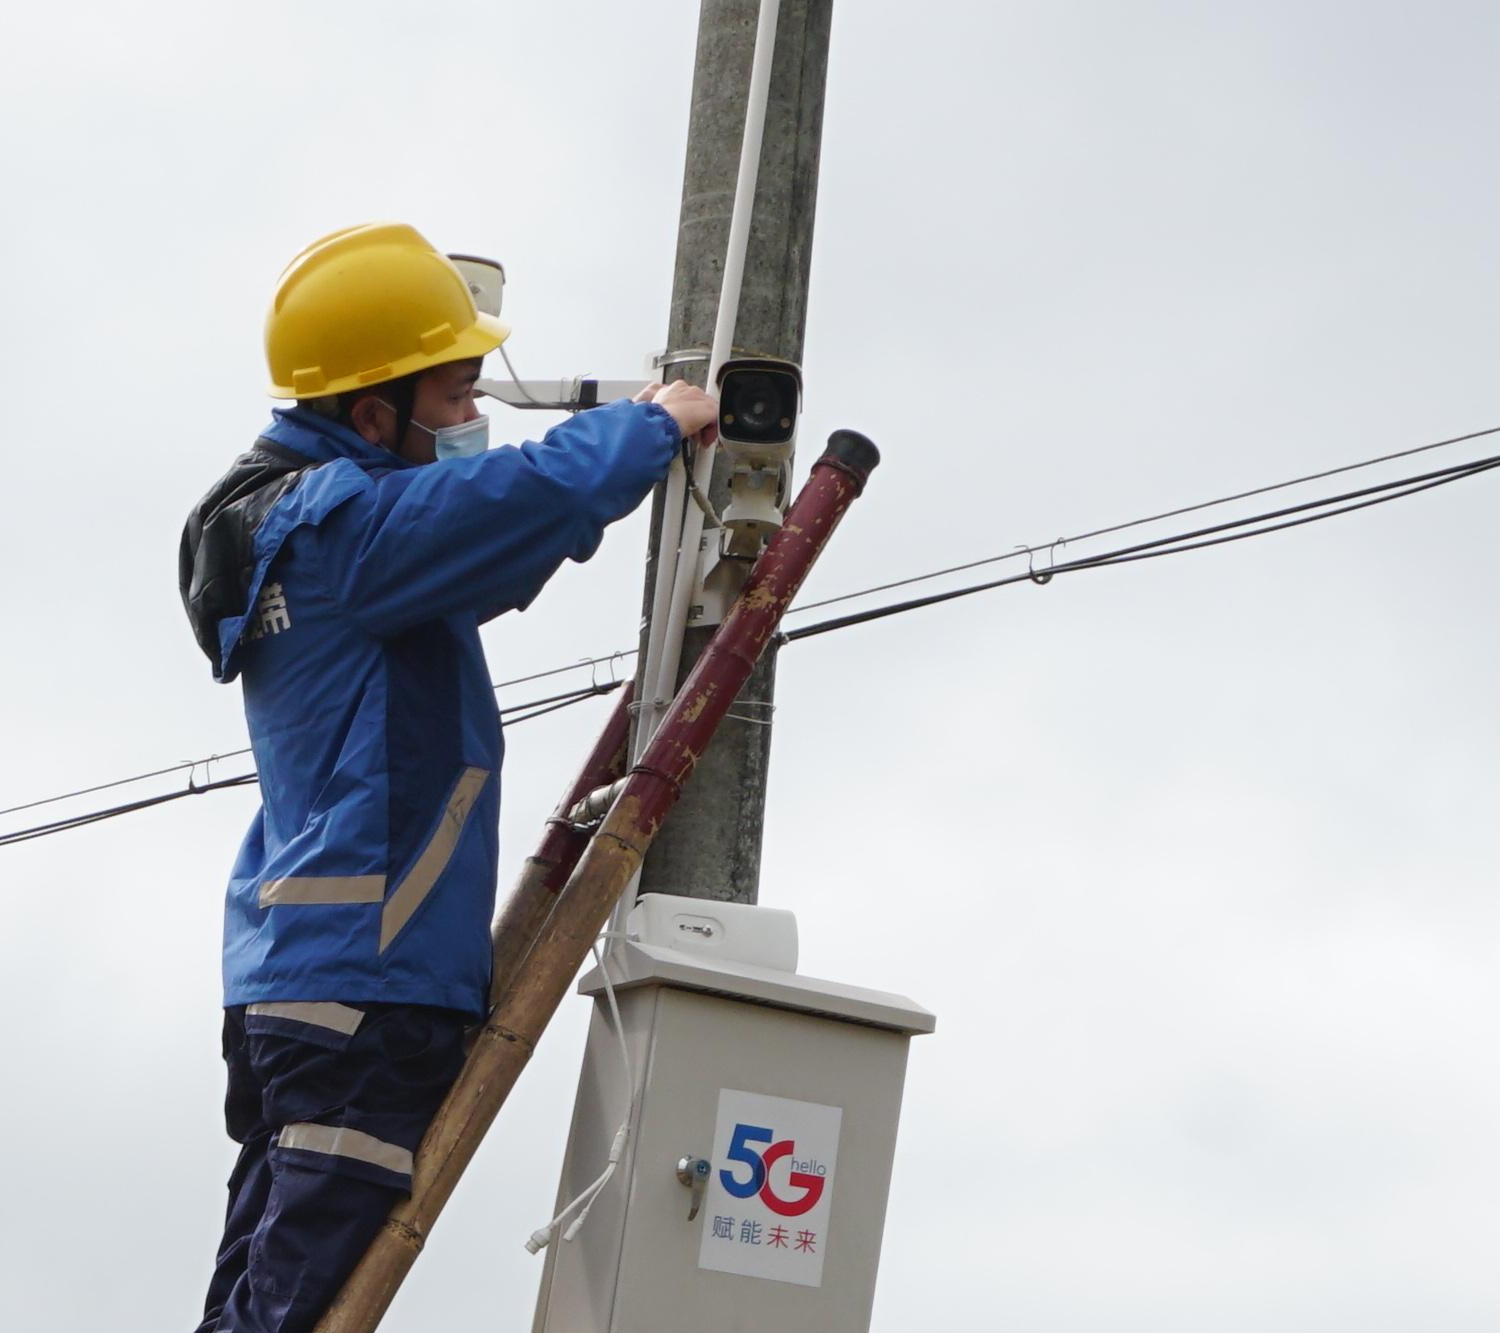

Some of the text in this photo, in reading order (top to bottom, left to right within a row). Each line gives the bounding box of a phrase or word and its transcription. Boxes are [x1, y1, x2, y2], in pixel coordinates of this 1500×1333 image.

[719, 1123, 826, 1217] 5G
[790, 1156, 827, 1176] hello
[711, 1215, 817, 1254] 赋能未来
